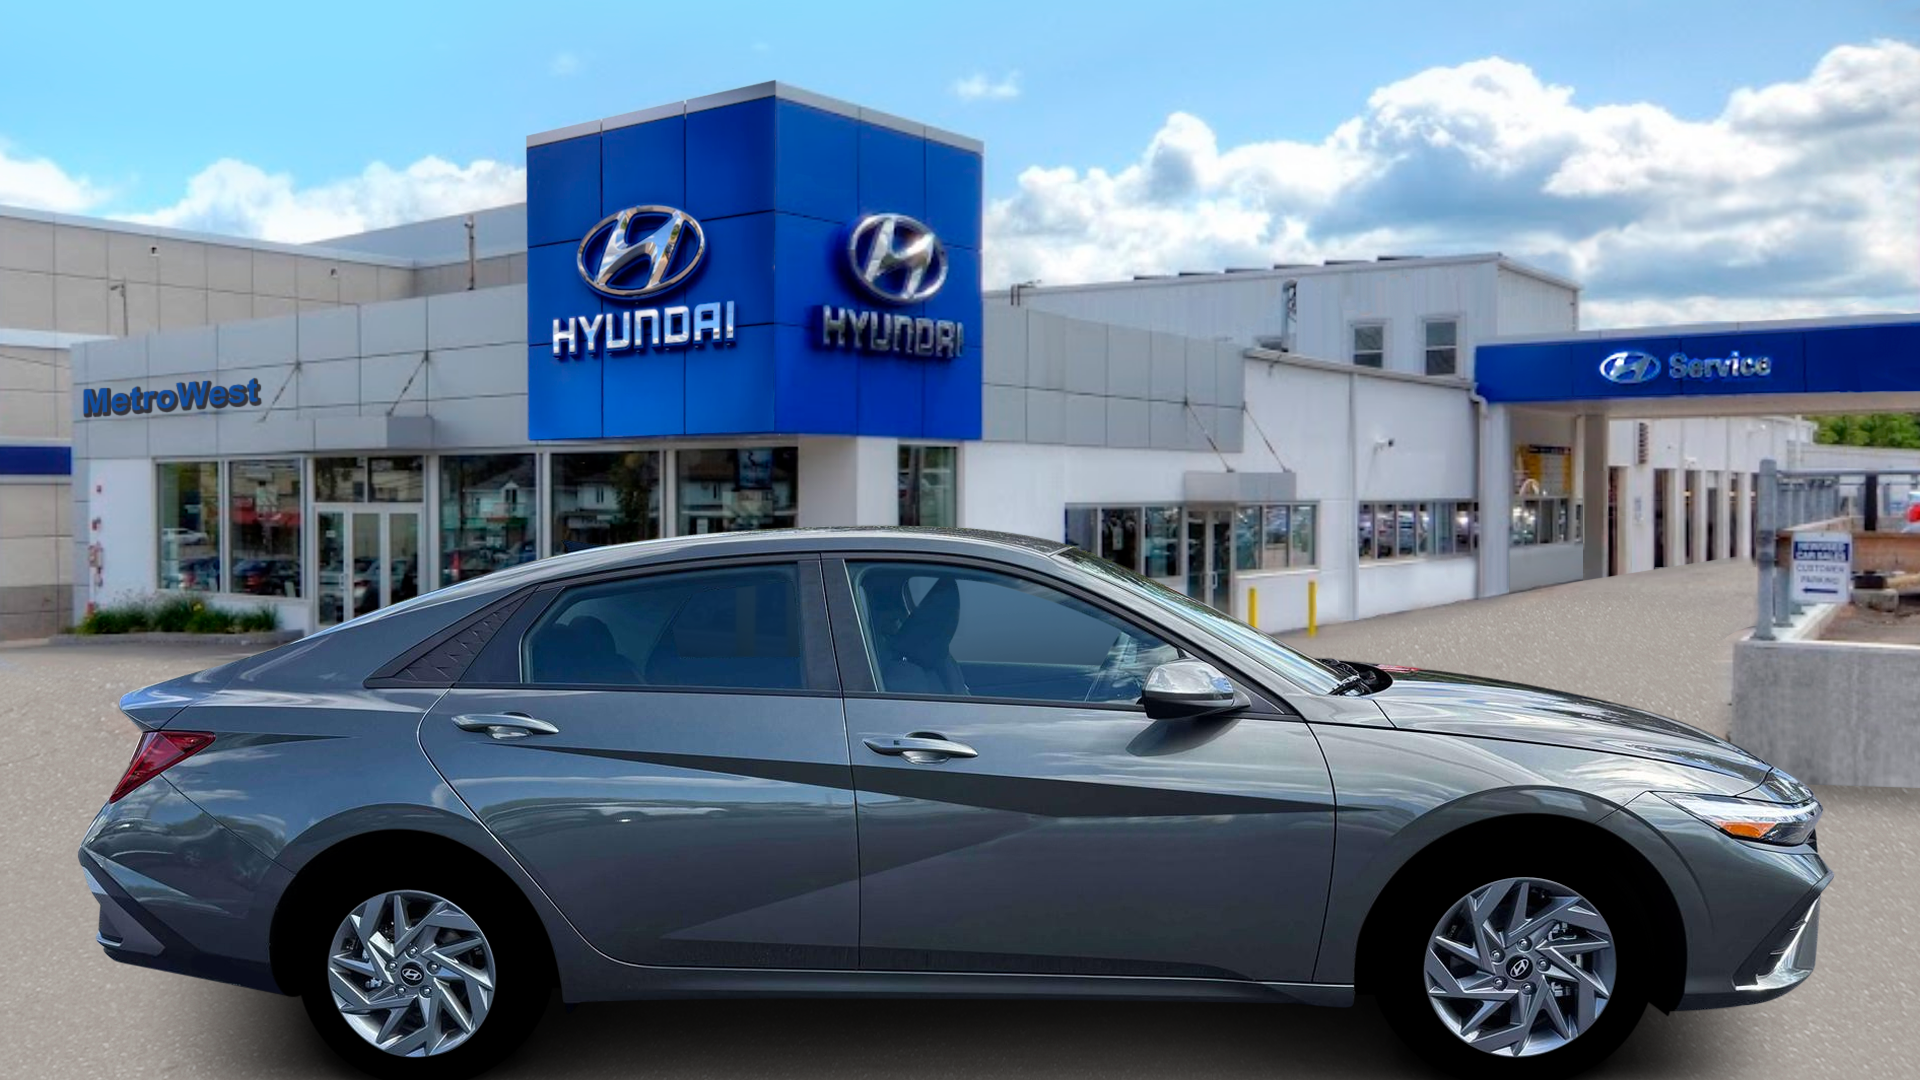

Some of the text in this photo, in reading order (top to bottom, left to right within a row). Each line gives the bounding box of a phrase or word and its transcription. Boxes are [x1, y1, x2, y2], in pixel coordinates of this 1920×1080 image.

[552, 300, 736, 356] HYUNDAI
[822, 304, 965, 358] HYUNDAI
[1669, 350, 1771, 378] Service
[83, 378, 262, 418] MetroWest
